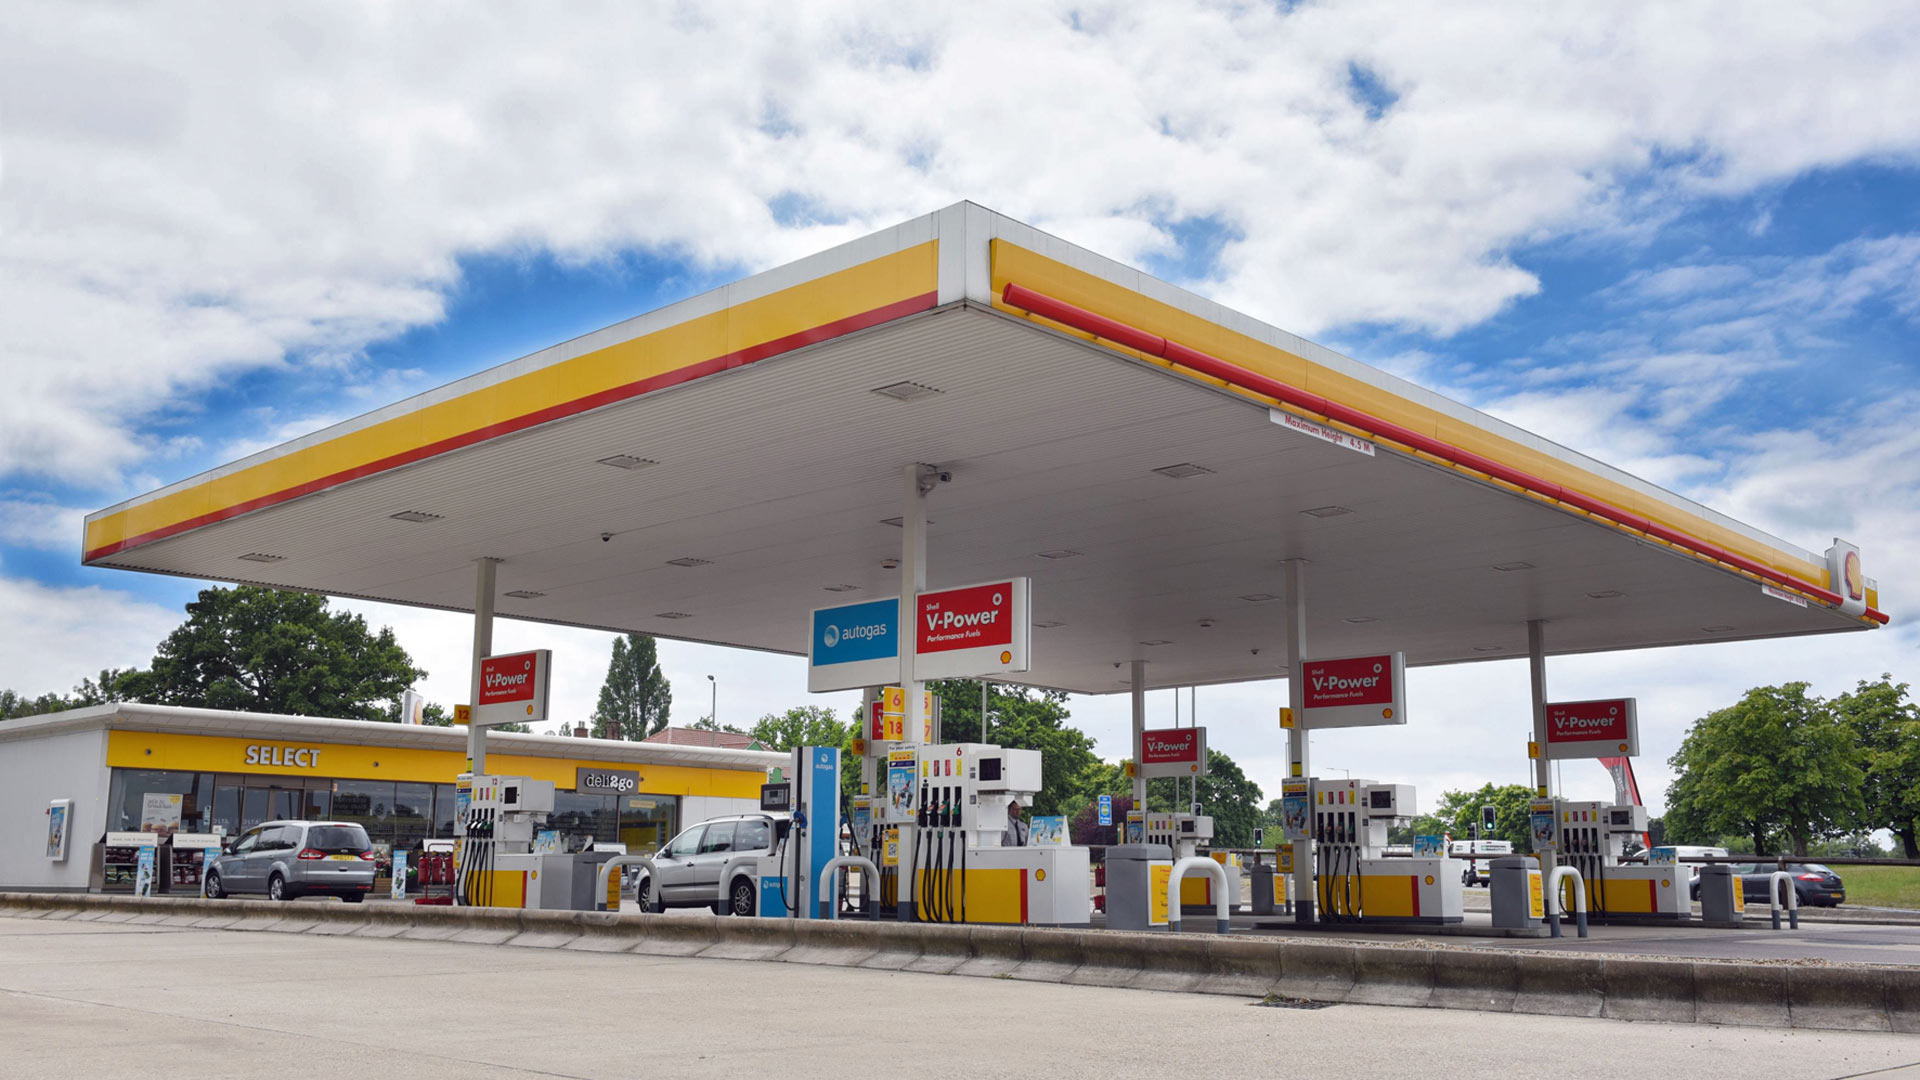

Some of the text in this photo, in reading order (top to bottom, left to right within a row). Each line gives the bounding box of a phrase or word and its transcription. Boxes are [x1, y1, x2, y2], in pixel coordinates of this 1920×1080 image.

[1284, 415, 1370, 452] Maximum Height 4.5 M
[926, 602, 940, 611] Shell
[926, 609, 998, 631] V-Power
[842, 623, 887, 640] autogas
[926, 629, 981, 643] Performance Fuels
[486, 672, 528, 688] V-Power
[1312, 676, 1380, 690] V-Power
[893, 694, 901, 706] 6
[1313, 690, 1364, 700] Performance Fuels
[458, 710, 469, 720] 12
[888, 721, 903, 735] 18
[1554, 717, 1615, 728] V-Power
[956, 748, 962, 756] 6
[1147, 742, 1190, 752] V-Power
[246, 745, 321, 768] SELECT
[586, 773, 634, 792] deli2go
